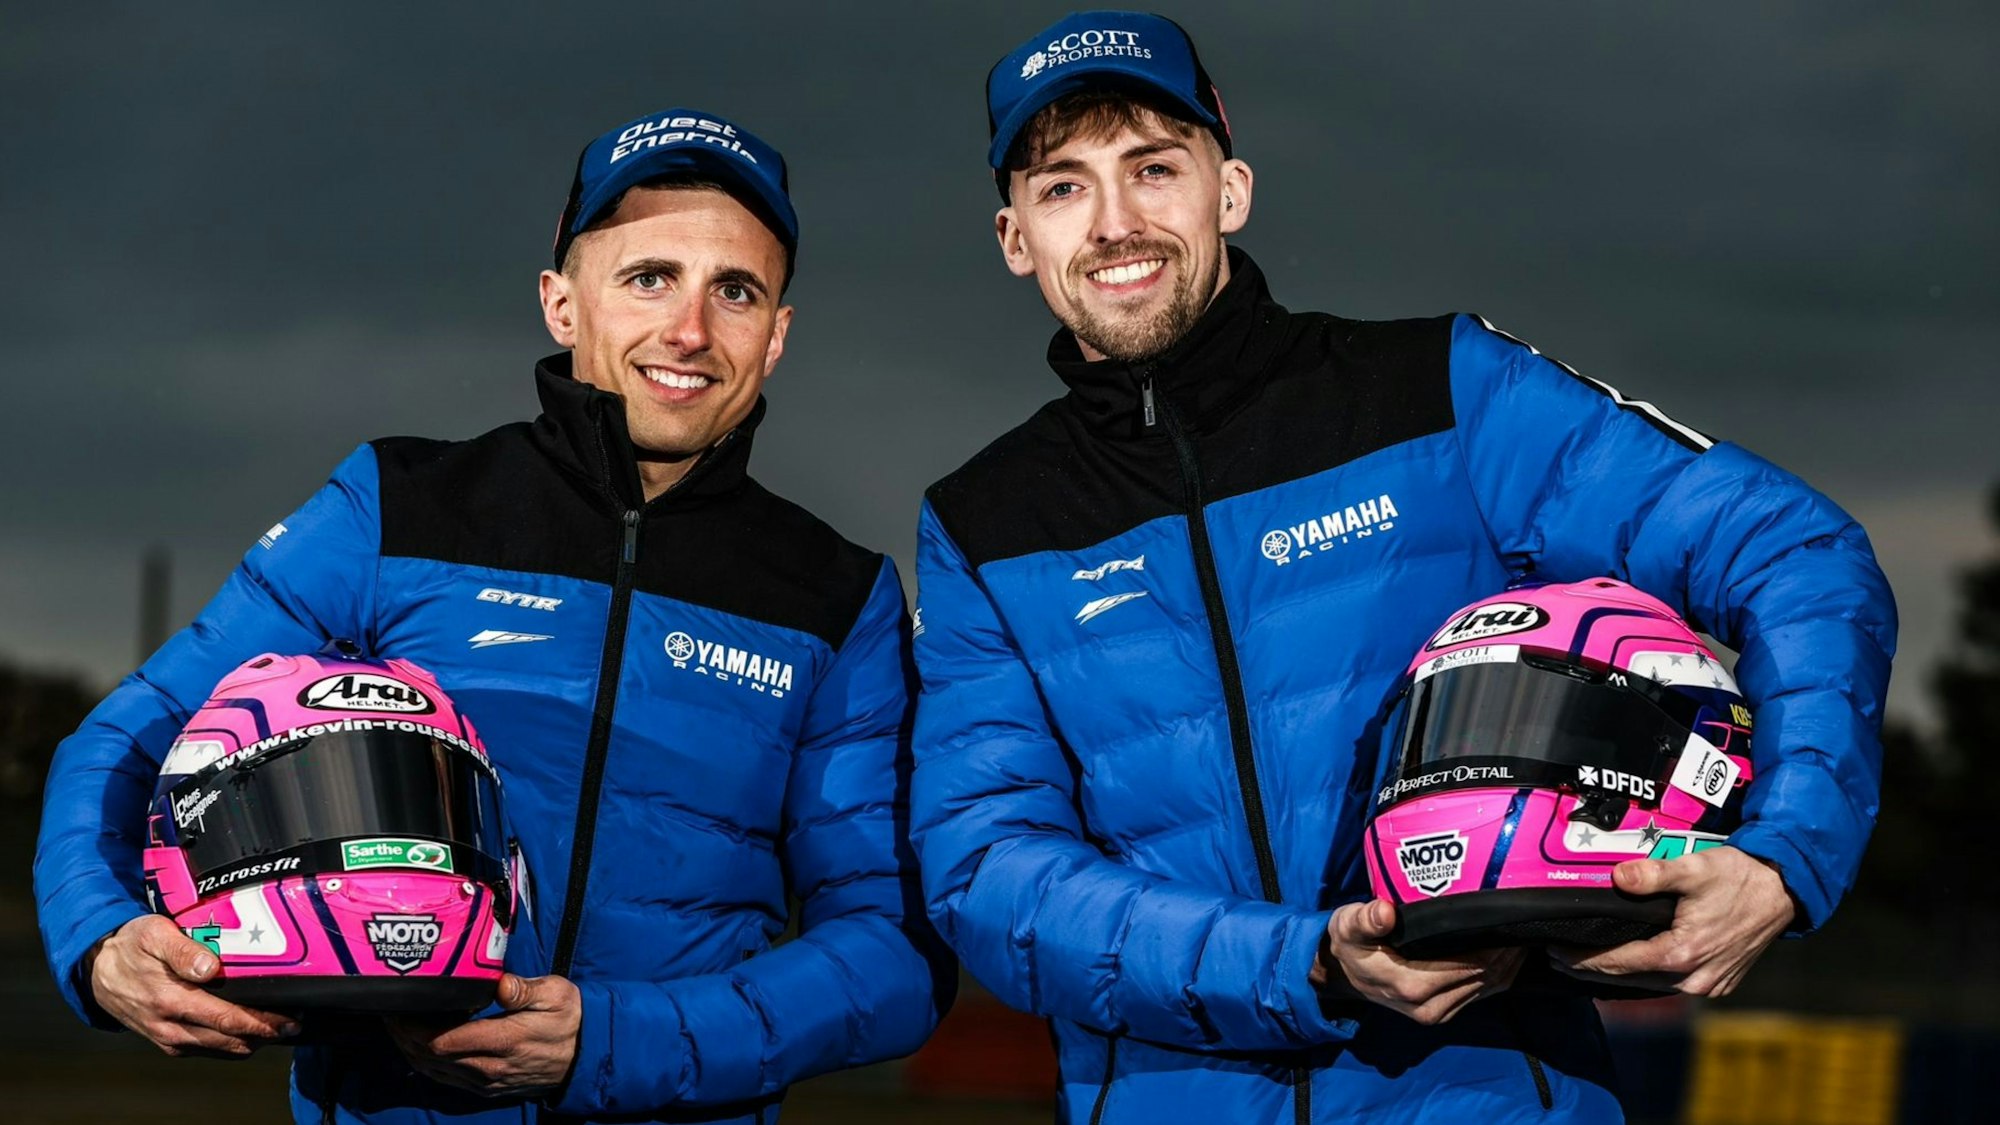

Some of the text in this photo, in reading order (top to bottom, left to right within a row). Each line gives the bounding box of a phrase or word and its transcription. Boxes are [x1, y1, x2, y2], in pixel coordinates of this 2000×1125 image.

[1047, 29, 1139, 58] SCOTT
[1048, 45, 1152, 68] PROPERTIES
[1289, 494, 1399, 549] YAMAHA
[1276, 521, 1394, 567] RACING
[476, 587, 563, 612] GYTR
[1428, 606, 1536, 650] Arai
[697, 639, 793, 692] YAMAHA
[1446, 646, 1492, 662] SCOTT
[307, 675, 423, 706] Arai
[673, 660, 784, 699] RACING
[347, 700, 399, 709] HELMET
[1393, 771, 1453, 797] PERFECT
[1452, 765, 1514, 782] DETAIL
[1601, 768, 1656, 801] DFDS
[348, 843, 404, 859] Sarthe
[1400, 841, 1464, 869] MOTO
[198, 857, 301, 895] 72.crossfit
[1408, 862, 1458, 877] FÉDÉRATION
[1411, 870, 1456, 882] FRANÇAISE
[367, 922, 440, 944] MOTO
[378, 951, 429, 959] FRANÇAISE
